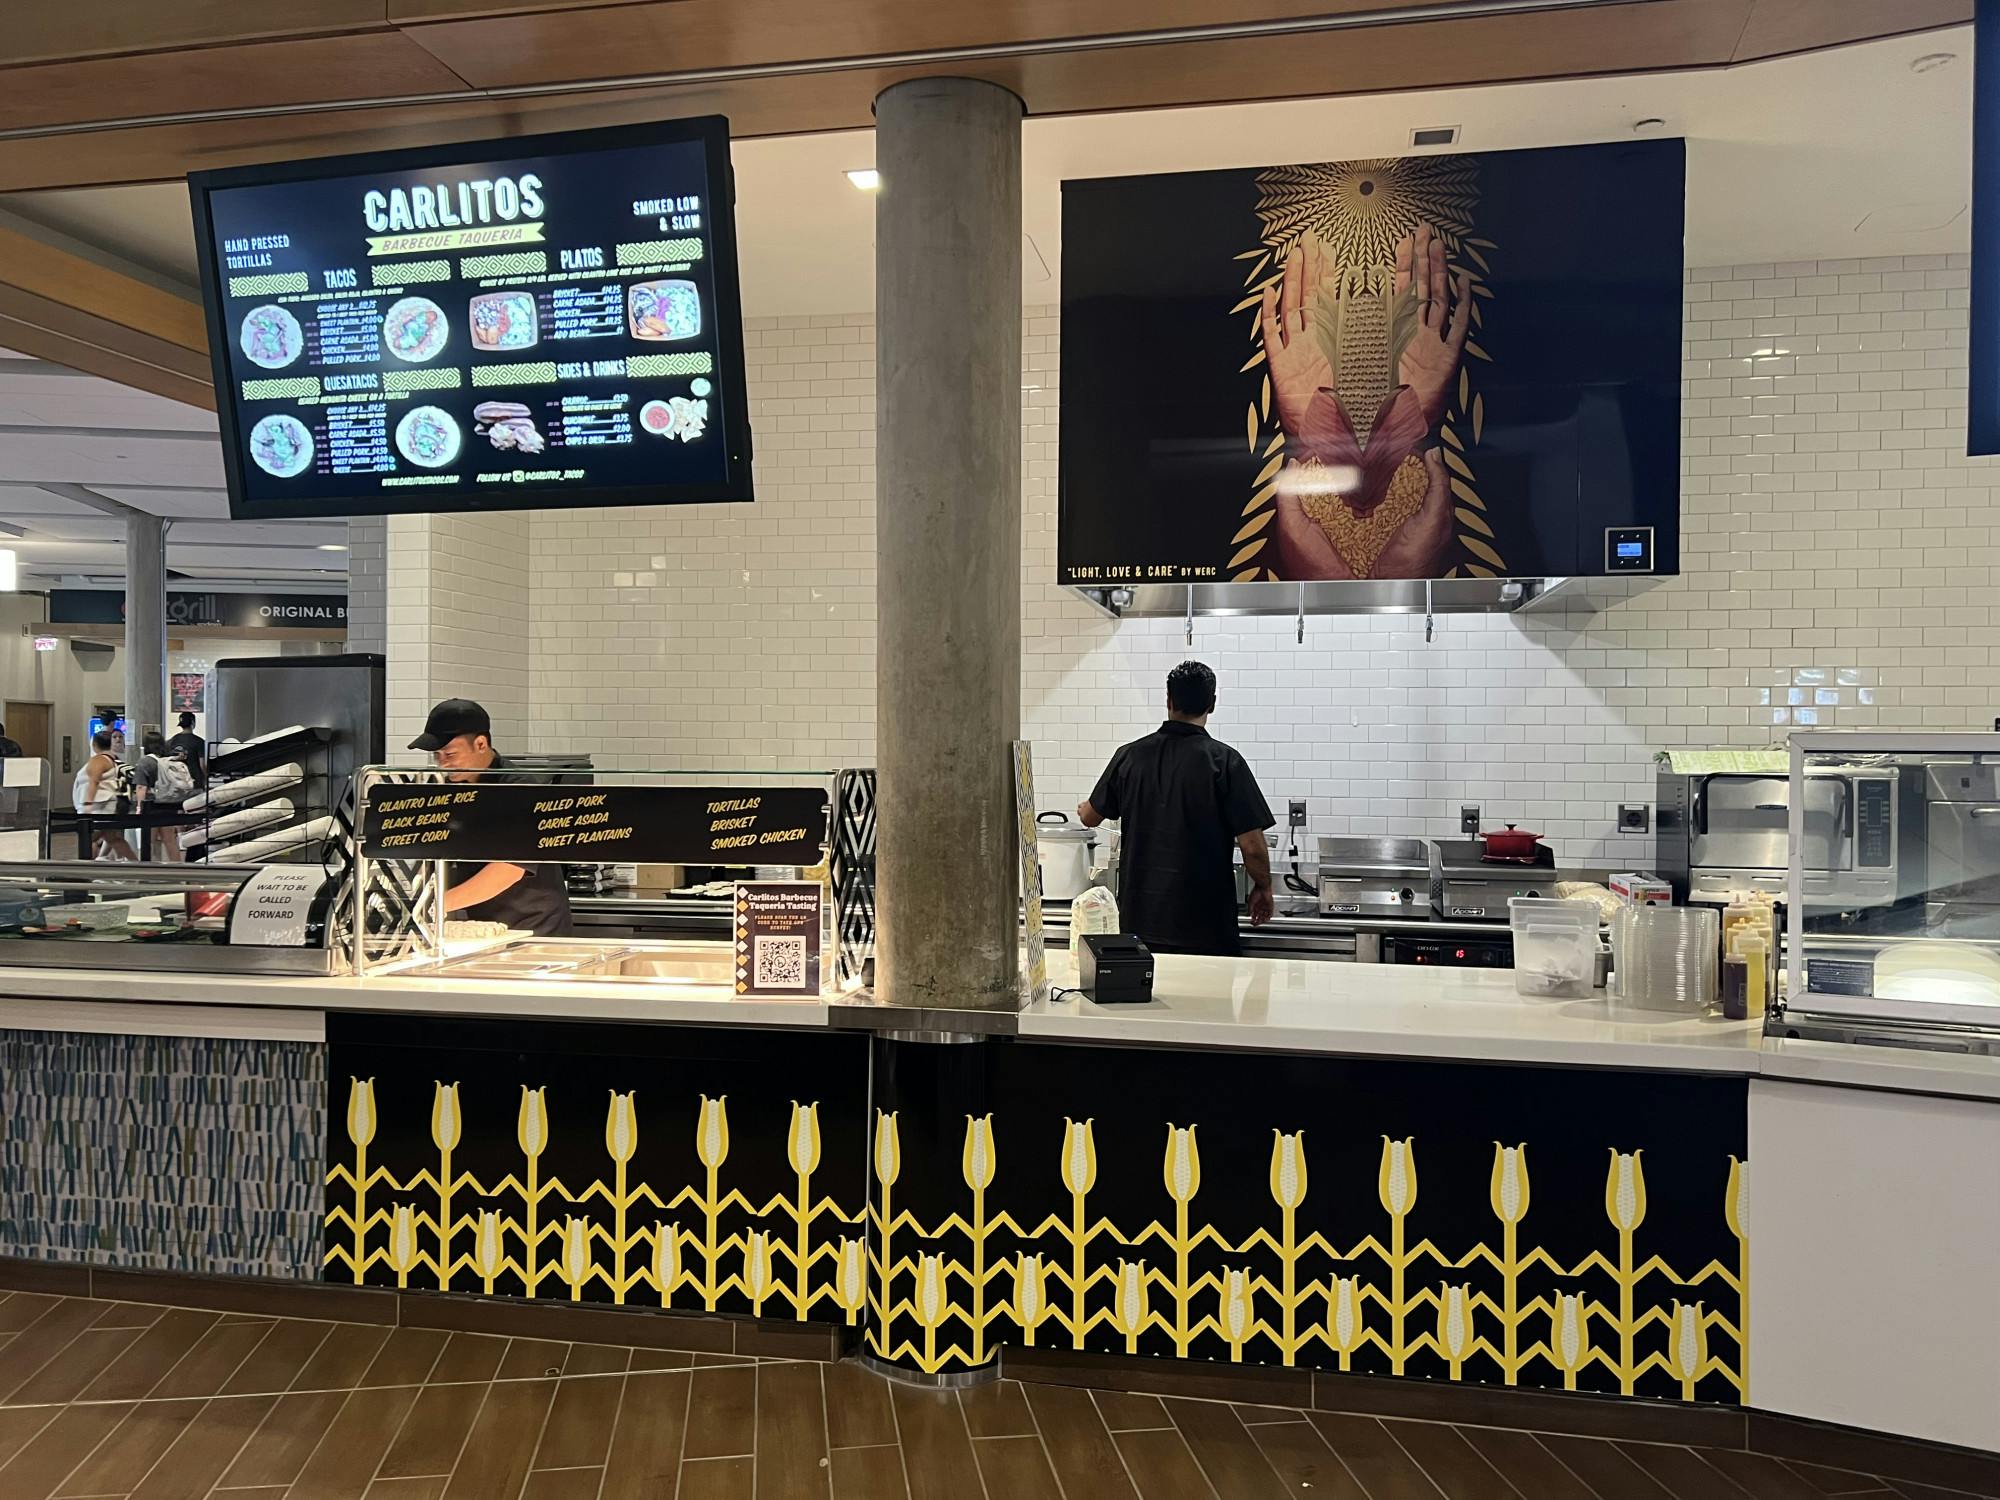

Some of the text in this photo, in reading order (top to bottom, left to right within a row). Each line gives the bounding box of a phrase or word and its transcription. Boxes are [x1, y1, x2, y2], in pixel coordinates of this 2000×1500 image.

[364, 173, 544, 232] CARLITOS
[633, 195, 700, 216] SMOKED LOW
[659, 215, 700, 231] & SLOW
[225, 234, 290, 253] HAND PRESSED
[382, 228, 523, 252] BARBECUE TAQUERIA
[226, 253, 272, 269] TORTILLAS
[560, 247, 604, 270] PLATOS
[323, 268, 357, 288] TACOS
[553, 298, 574, 308] CARNE
[554, 309, 581, 318] CHICKEN
[555, 319, 578, 329] PULLED
[557, 359, 625, 378] SIDES & DRINKS
[324, 373, 378, 391] QUESATACOS
[476, 473, 501, 483] FOLLOW
[1067, 565, 1216, 578] "LIGHT, LOVE & CARE" BY WERC
[259, 606, 333, 618] ORIGINAL
[378, 790, 479, 813] CILANTRO LIME RICE
[533, 794, 608, 813] PULLED PORK
[706, 797, 761, 814] TORTILLAS
[381, 811, 450, 830] BLACK BEANS
[537, 811, 609, 831] CARNE ASADA
[710, 815, 757, 832] BRISKET
[381, 830, 451, 848] STREET CORN
[537, 827, 633, 849] SWEET PLANTAINS
[710, 828, 807, 850] SMOKED CHICKEN
[258, 896, 292, 904] CALLED
[748, 893, 818, 901] Carlitos Barbecue
[248, 910, 294, 919] FORWARD
[749, 902, 817, 911] Taqueria Tasting
